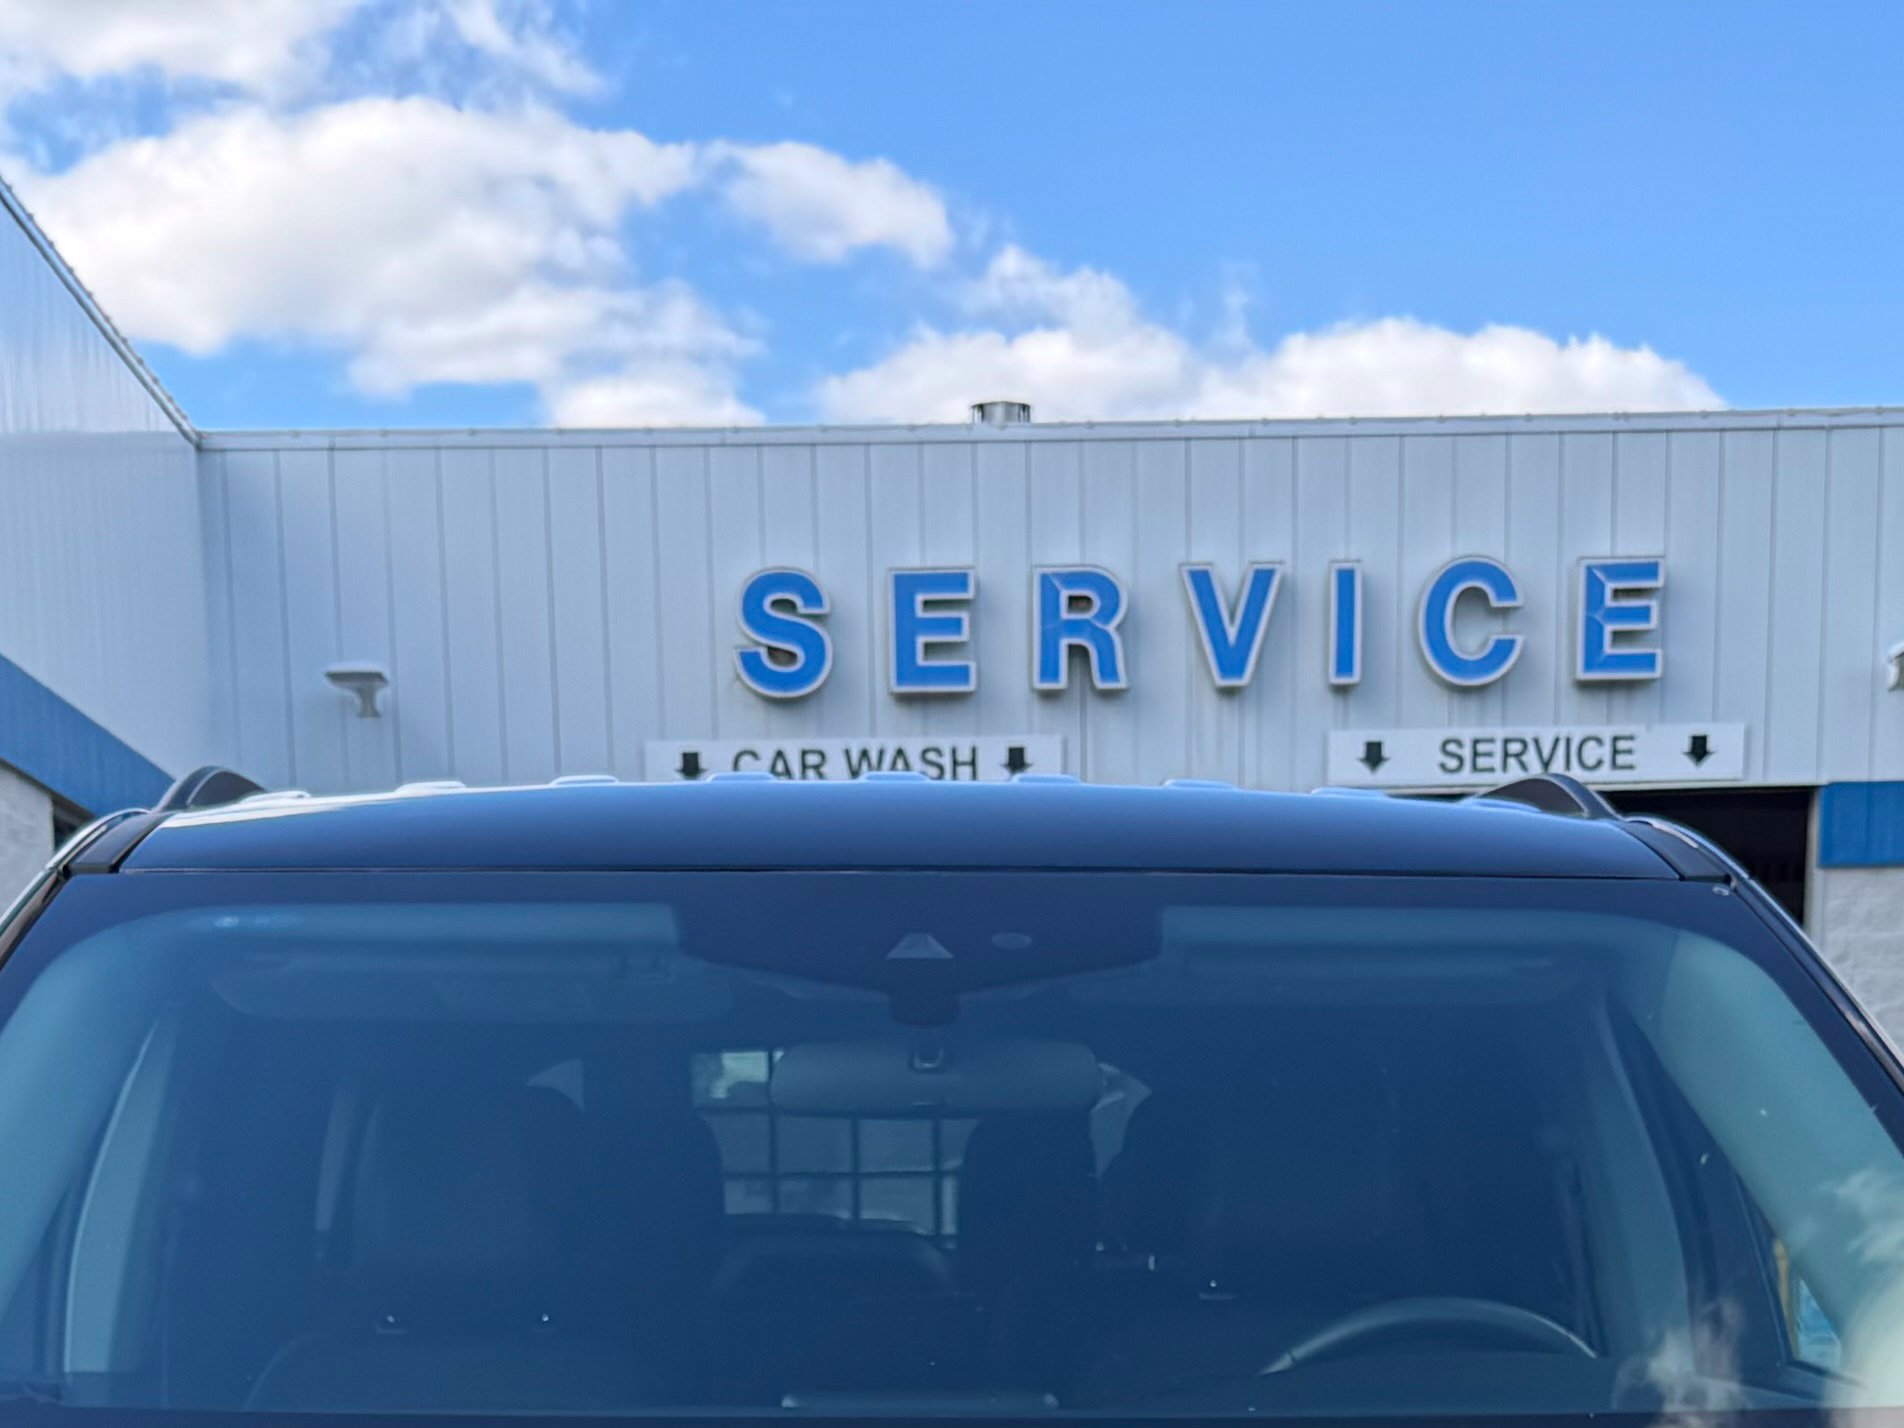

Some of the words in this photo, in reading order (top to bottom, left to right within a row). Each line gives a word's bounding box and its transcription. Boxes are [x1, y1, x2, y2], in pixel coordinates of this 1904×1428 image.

[735, 555, 1665, 698] SERVICE
[732, 748, 827, 781] CAR
[844, 745, 979, 781] WASH
[1438, 735, 1638, 774] SERVICE
